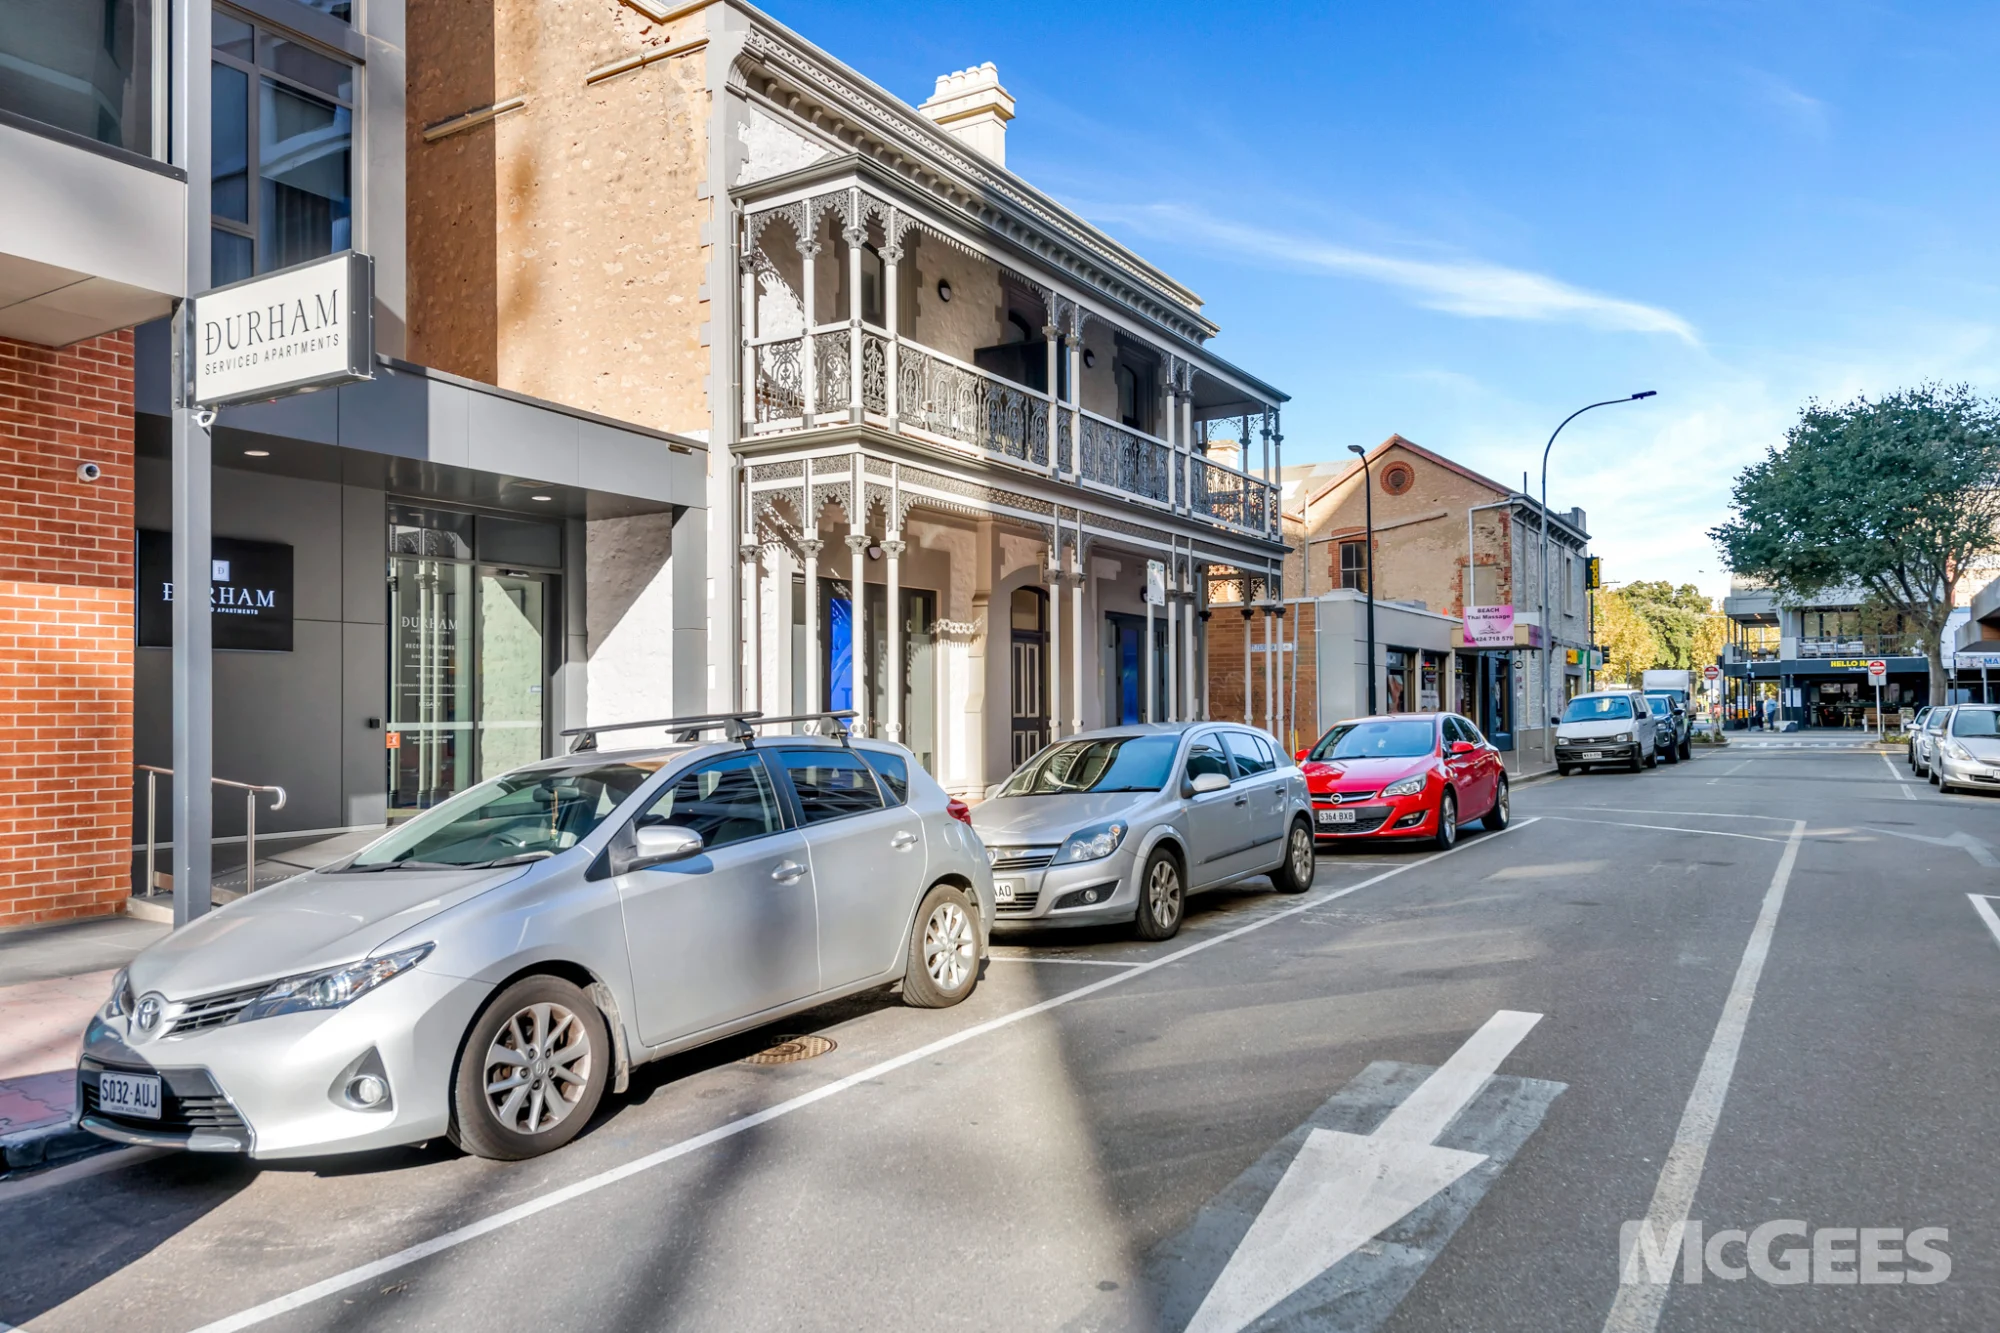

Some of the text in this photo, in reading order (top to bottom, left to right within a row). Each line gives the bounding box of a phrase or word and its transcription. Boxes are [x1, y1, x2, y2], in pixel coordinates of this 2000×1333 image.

[205, 333, 339, 375] SERVICED APARTMENTS
[217, 607, 259, 615] APARTMENTS
[1830, 660, 1859, 668] HELLO
